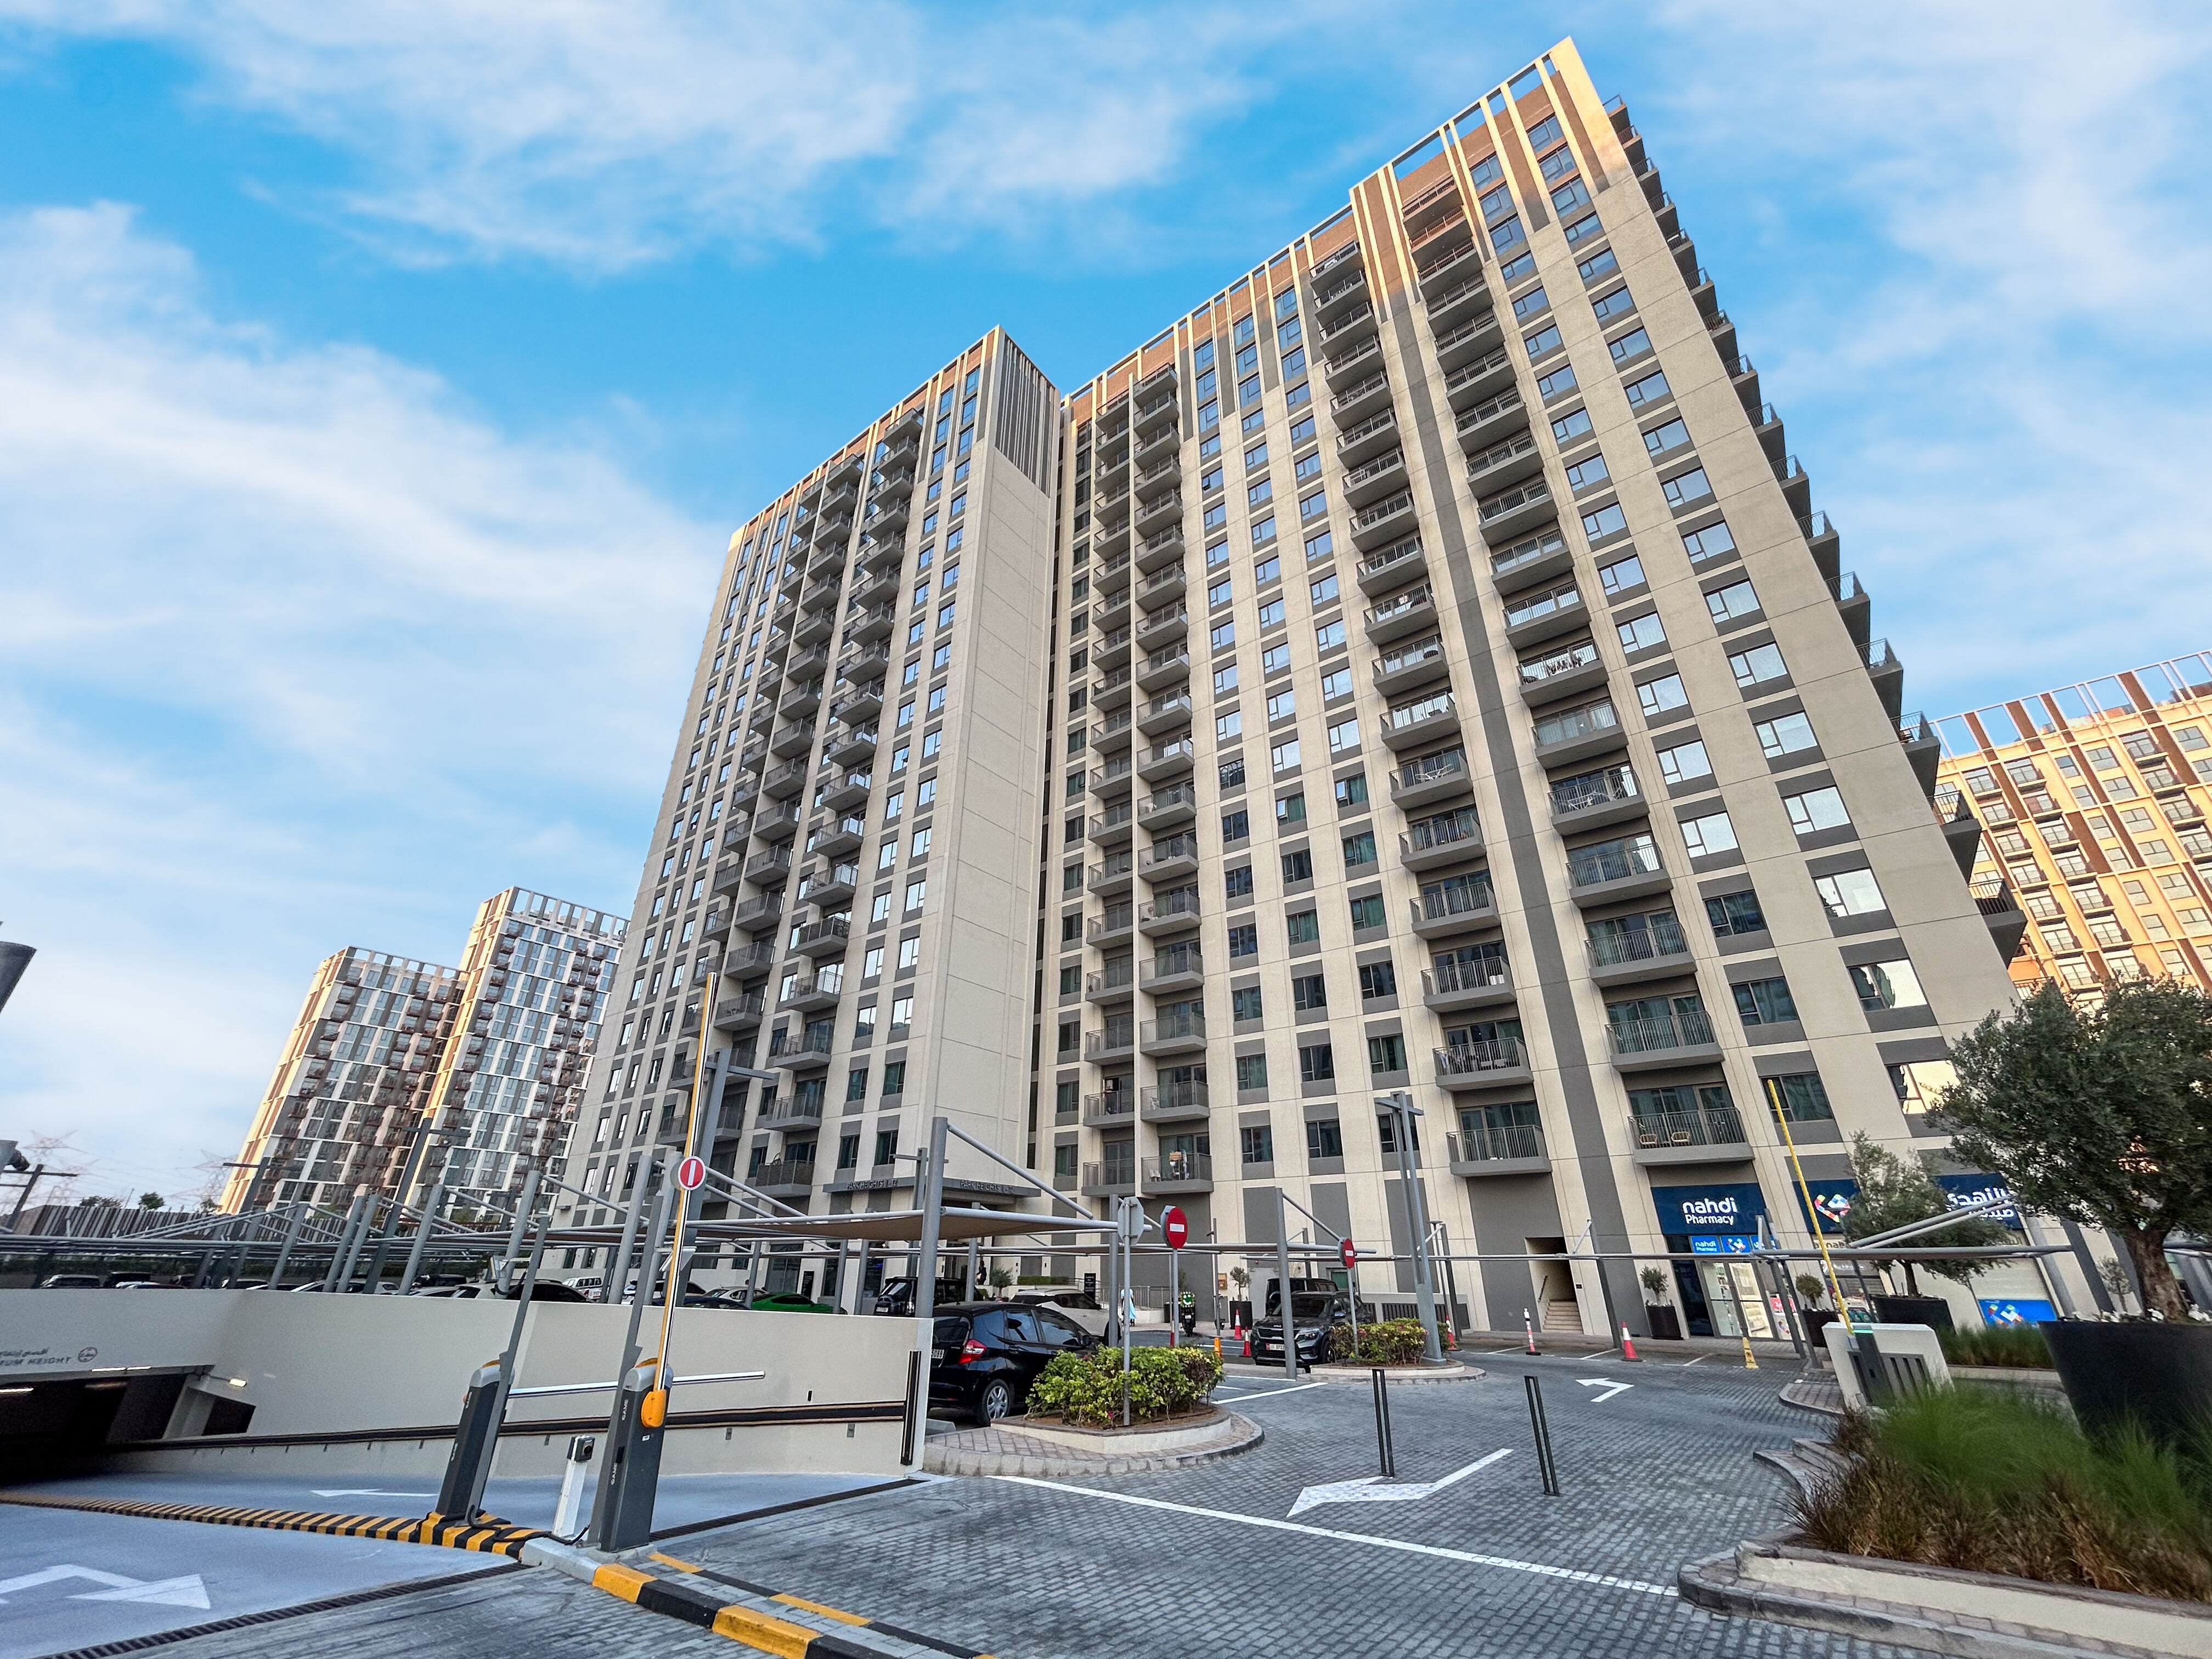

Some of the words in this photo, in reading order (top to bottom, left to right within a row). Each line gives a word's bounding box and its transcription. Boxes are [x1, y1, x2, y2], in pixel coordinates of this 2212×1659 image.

[860, 1179, 884, 1189] HEIGHTS
[961, 1180, 975, 1190] PARK
[1683, 1198, 1738, 1214] nahdi
[1685, 1215, 1734, 1225] Pharmacy
